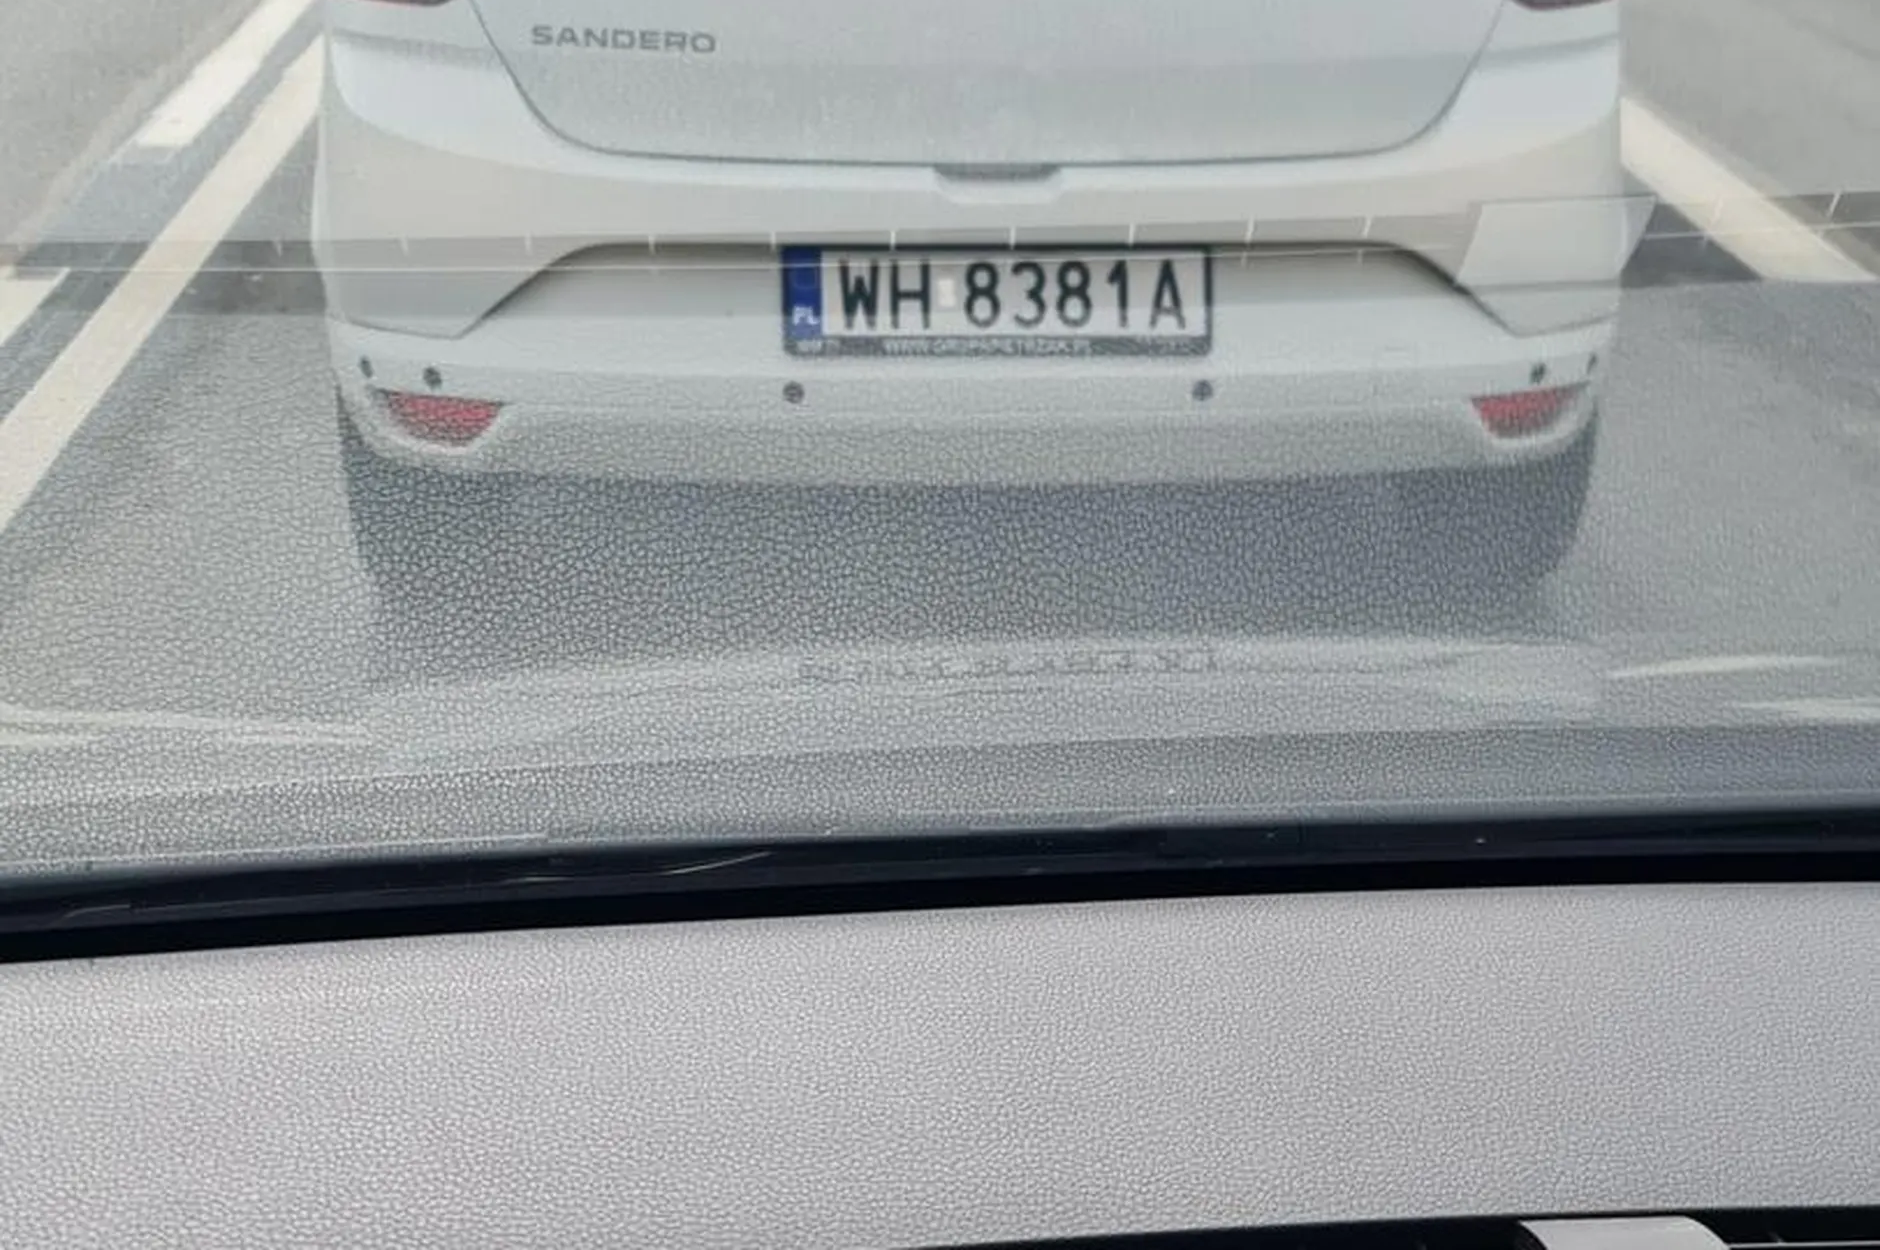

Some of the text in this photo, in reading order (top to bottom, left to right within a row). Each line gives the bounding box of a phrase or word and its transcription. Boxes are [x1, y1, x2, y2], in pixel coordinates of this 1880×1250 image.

[531, 24, 717, 55] SANDERO
[838, 258, 1187, 330] WH 8381A
[792, 306, 820, 326] PL
